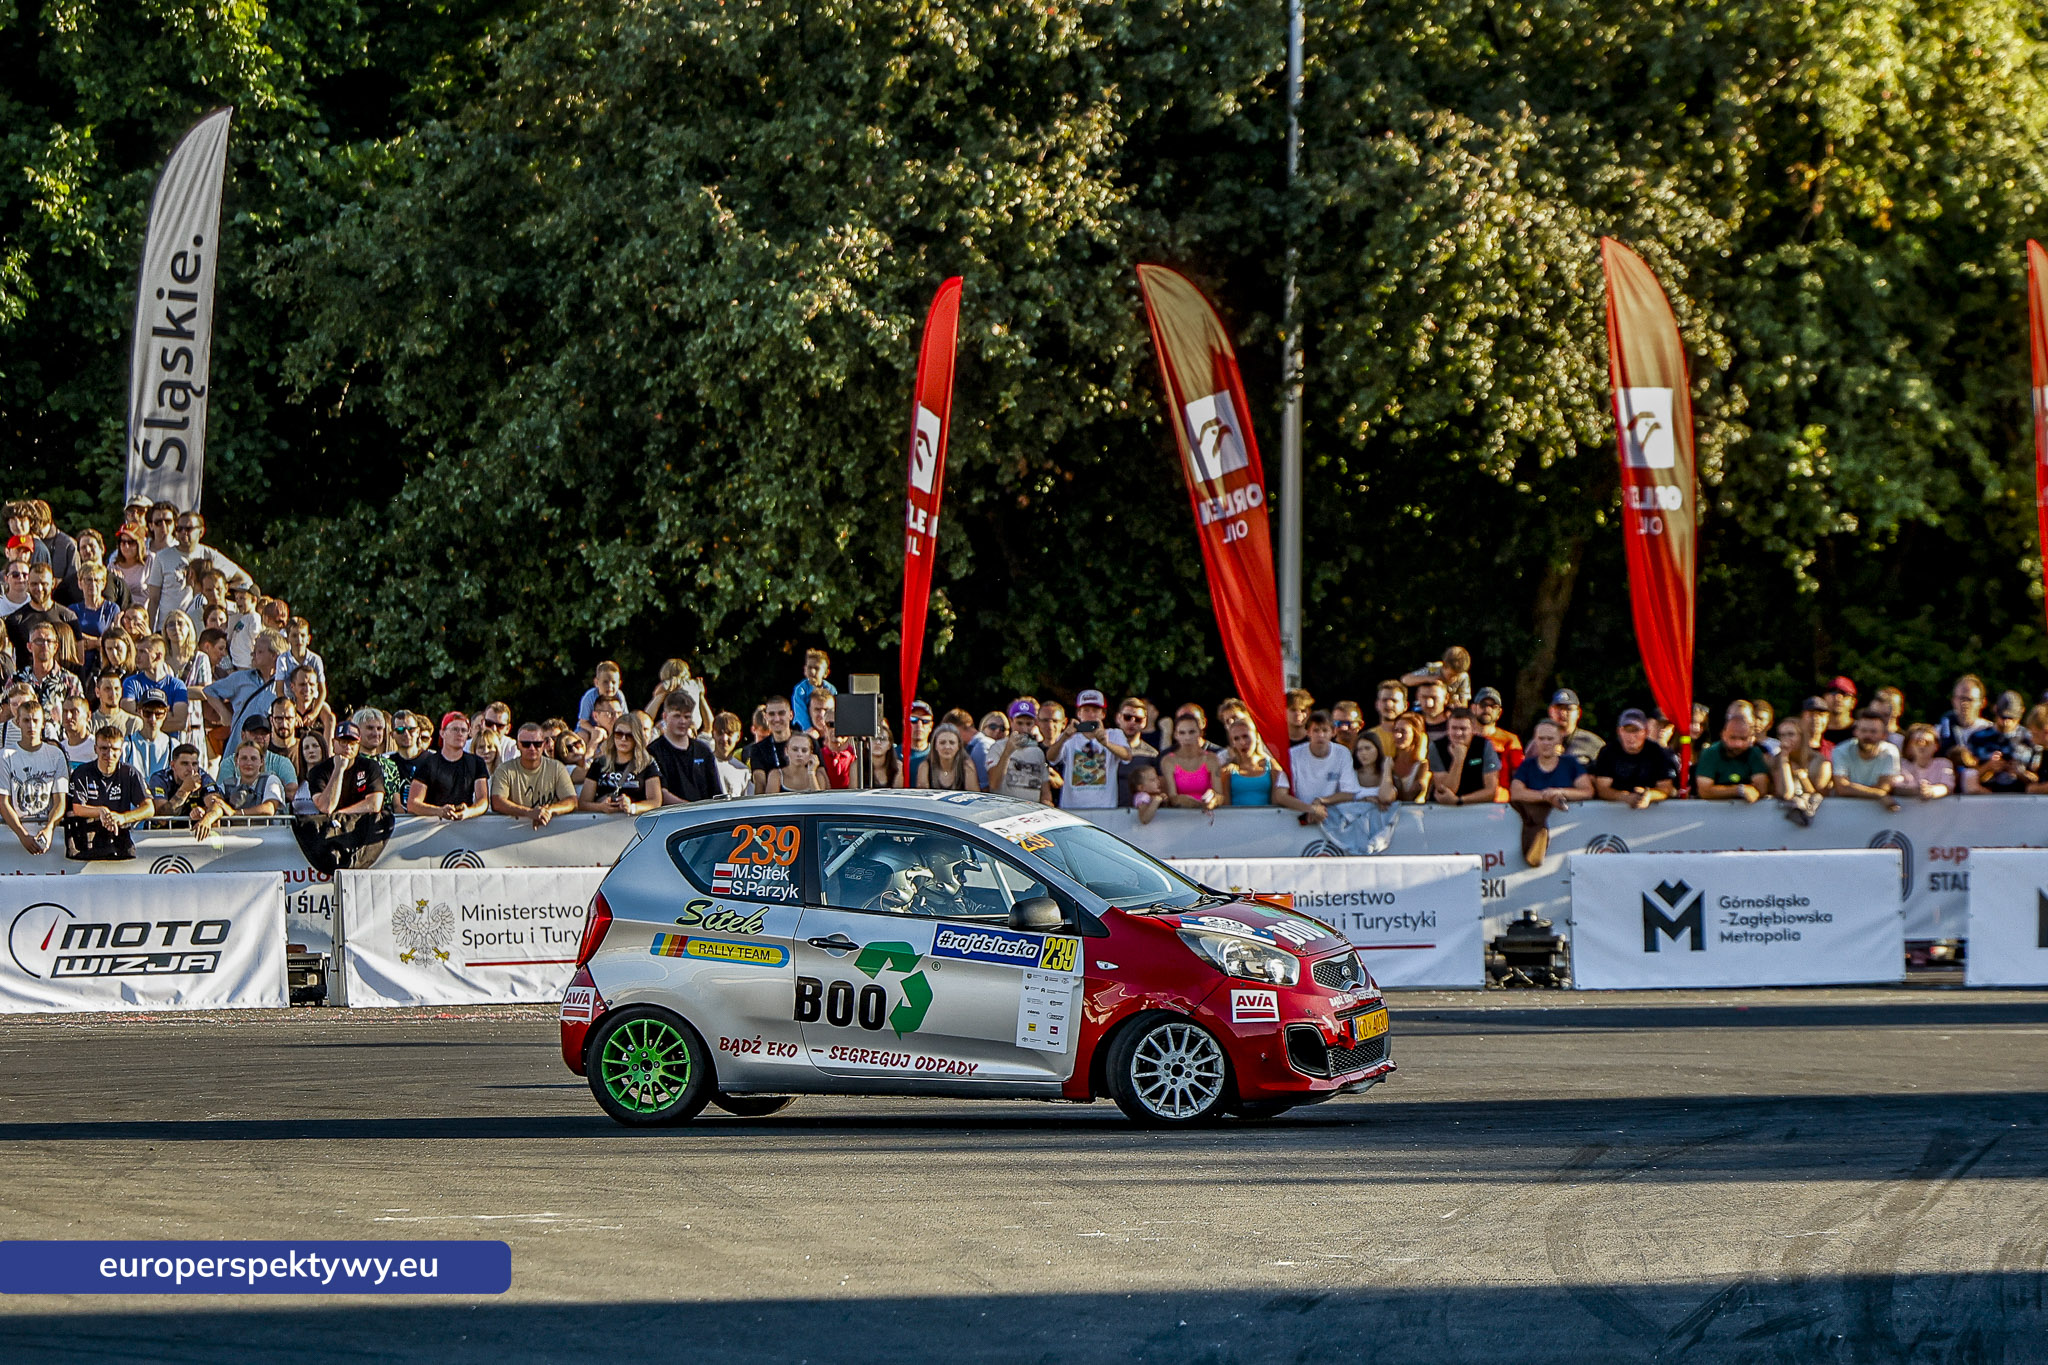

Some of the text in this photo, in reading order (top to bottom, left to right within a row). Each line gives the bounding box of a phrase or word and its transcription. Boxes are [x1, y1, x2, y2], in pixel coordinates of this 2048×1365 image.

[134, 234, 205, 473] Śląskie.
[728, 824, 801, 866] 239
[733, 864, 790, 881] M.Sitek
[731, 880, 799, 901] S.Parzyk
[1294, 889, 1395, 908] inisterstwo
[461, 903, 584, 922] Ministerstwo
[674, 897, 770, 935] Sitek
[1352, 911, 1437, 932] Turystyki
[60, 919, 231, 950] MOTO
[461, 926, 582, 949] Sportu i Tury
[937, 931, 1039, 958] #rajdslaska
[1720, 928, 1802, 945] Metropolia
[55, 952, 217, 974] WIZJA
[698, 944, 771, 960] RALLY TEAM
[1040, 938, 1078, 971] 239
[719, 1035, 762, 1057] BĄDŹ
[767, 1040, 798, 1058] EKO
[829, 1046, 910, 1068] SEGREGUJ
[914, 1055, 979, 1077] ODPADY
